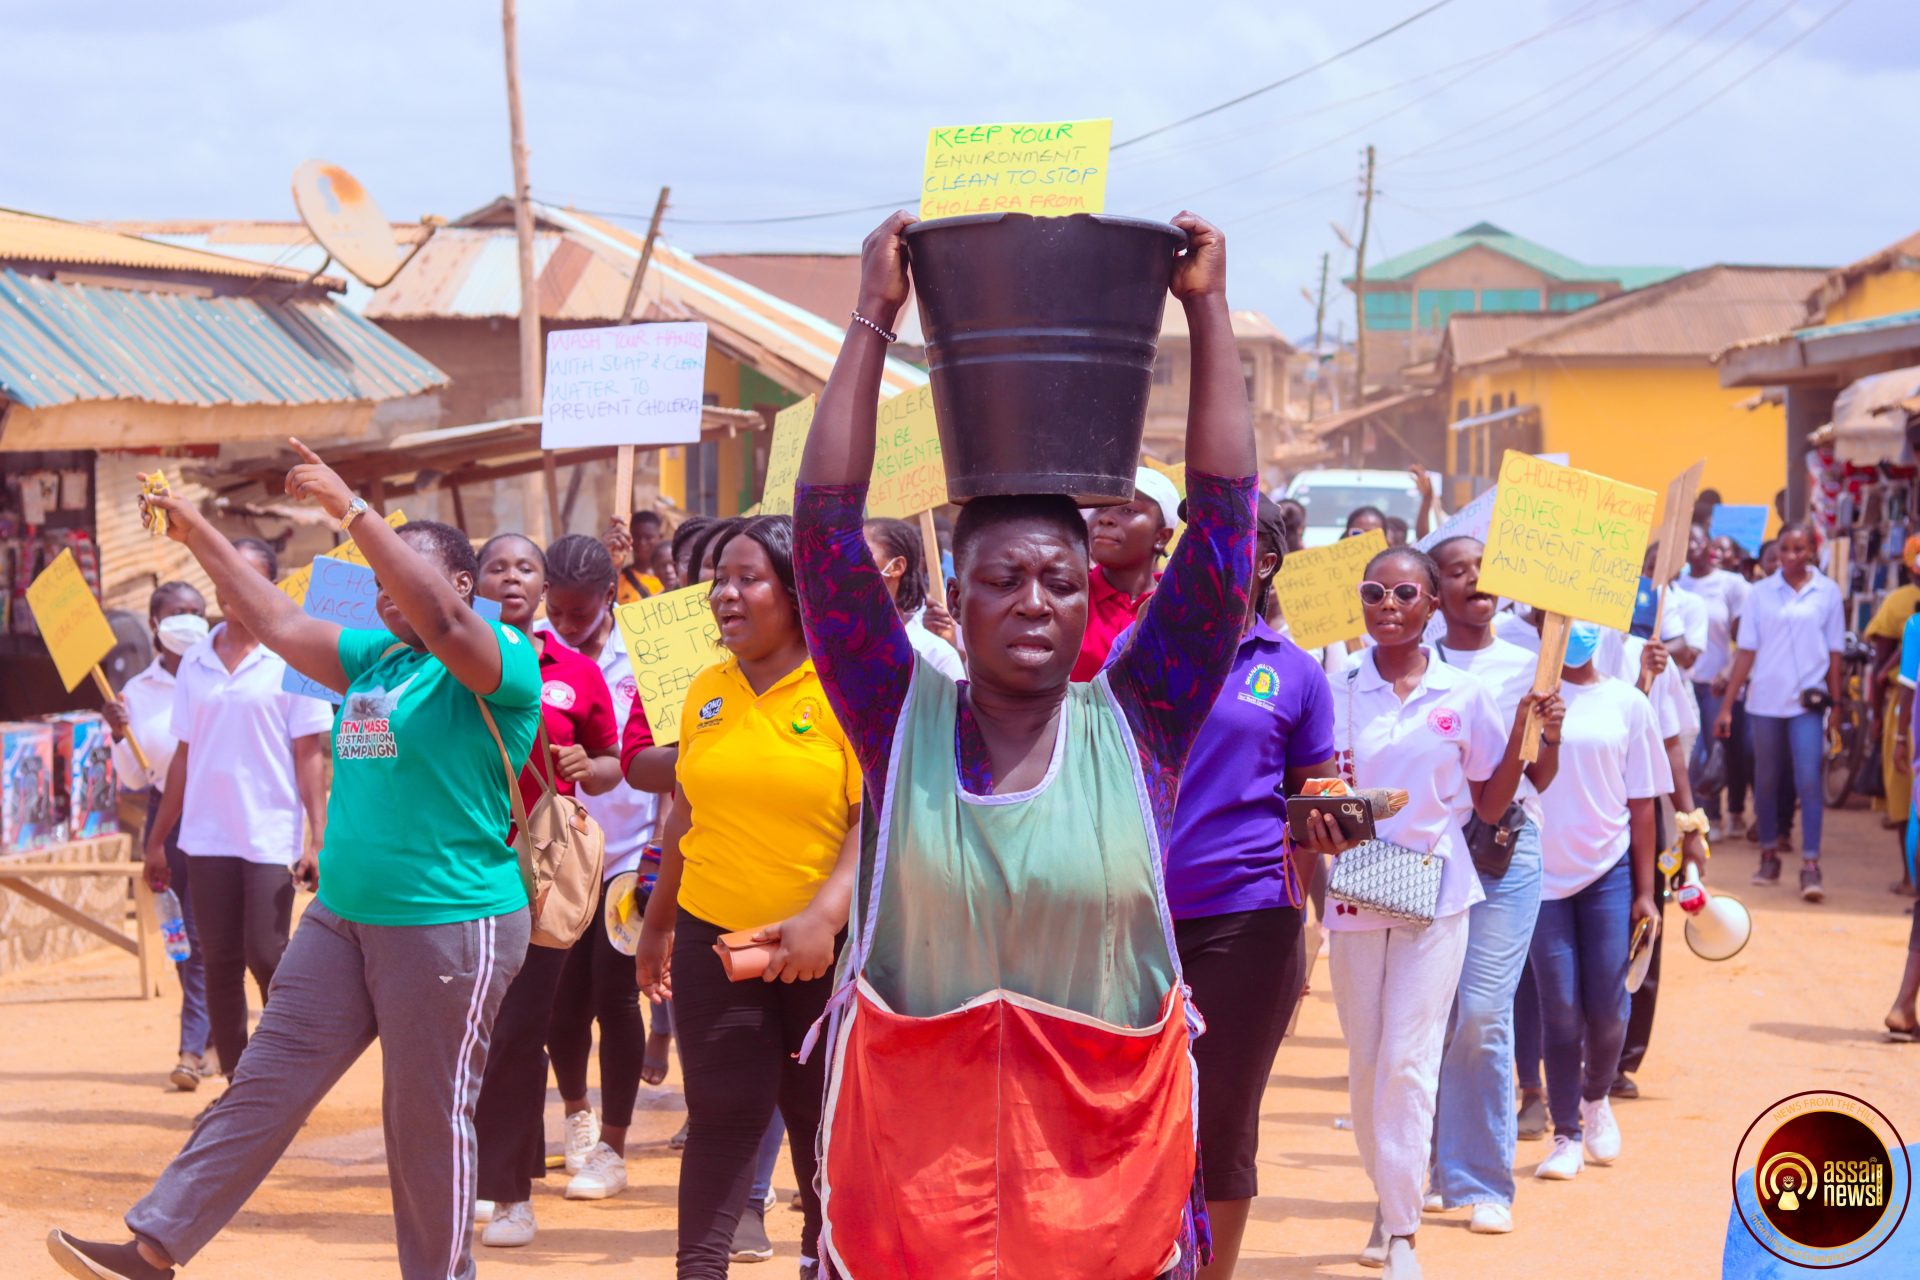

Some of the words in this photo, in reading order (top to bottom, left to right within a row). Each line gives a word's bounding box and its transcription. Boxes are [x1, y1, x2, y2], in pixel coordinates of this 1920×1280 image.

[935, 125, 1002, 148] KEEP
[1010, 123, 1073, 144] YOUR
[934, 146, 1087, 169] ENVIRONMENT
[925, 172, 1000, 193] CLEAN
[922, 195, 1023, 217] CHOLERA
[1029, 193, 1085, 210] FROM
[551, 331, 601, 351] WASH
[605, 330, 650, 349] YOUR
[655, 330, 705, 349] HANDS
[550, 357, 594, 376] WITH
[600, 352, 650, 372] SOAP
[663, 354, 705, 371] CLEAN
[551, 380, 619, 401] WATER
[630, 377, 650, 395] TO
[550, 399, 632, 422] PREVENT
[636, 399, 699, 417] CHOLERA
[878, 387, 935, 426] OLER
[893, 426, 913, 447] BE
[868, 478, 894, 507] GET
[897, 485, 946, 515] TODAY
[1504, 456, 1589, 500] CHOLERA
[1595, 480, 1657, 524] VACCINE
[1499, 487, 1565, 529] SAVES
[1498, 519, 1586, 563] PREVENT
[1278, 572, 1315, 593] HAVE
[1325, 566, 1343, 582] TO
[1491, 550, 1528, 575] AND
[1534, 558, 1581, 592] YOUR
[1290, 612, 1339, 639] SAVES
[635, 637, 670, 665] BE
[638, 664, 704, 702] SEEK
[363, 719, 389, 733] MASS
